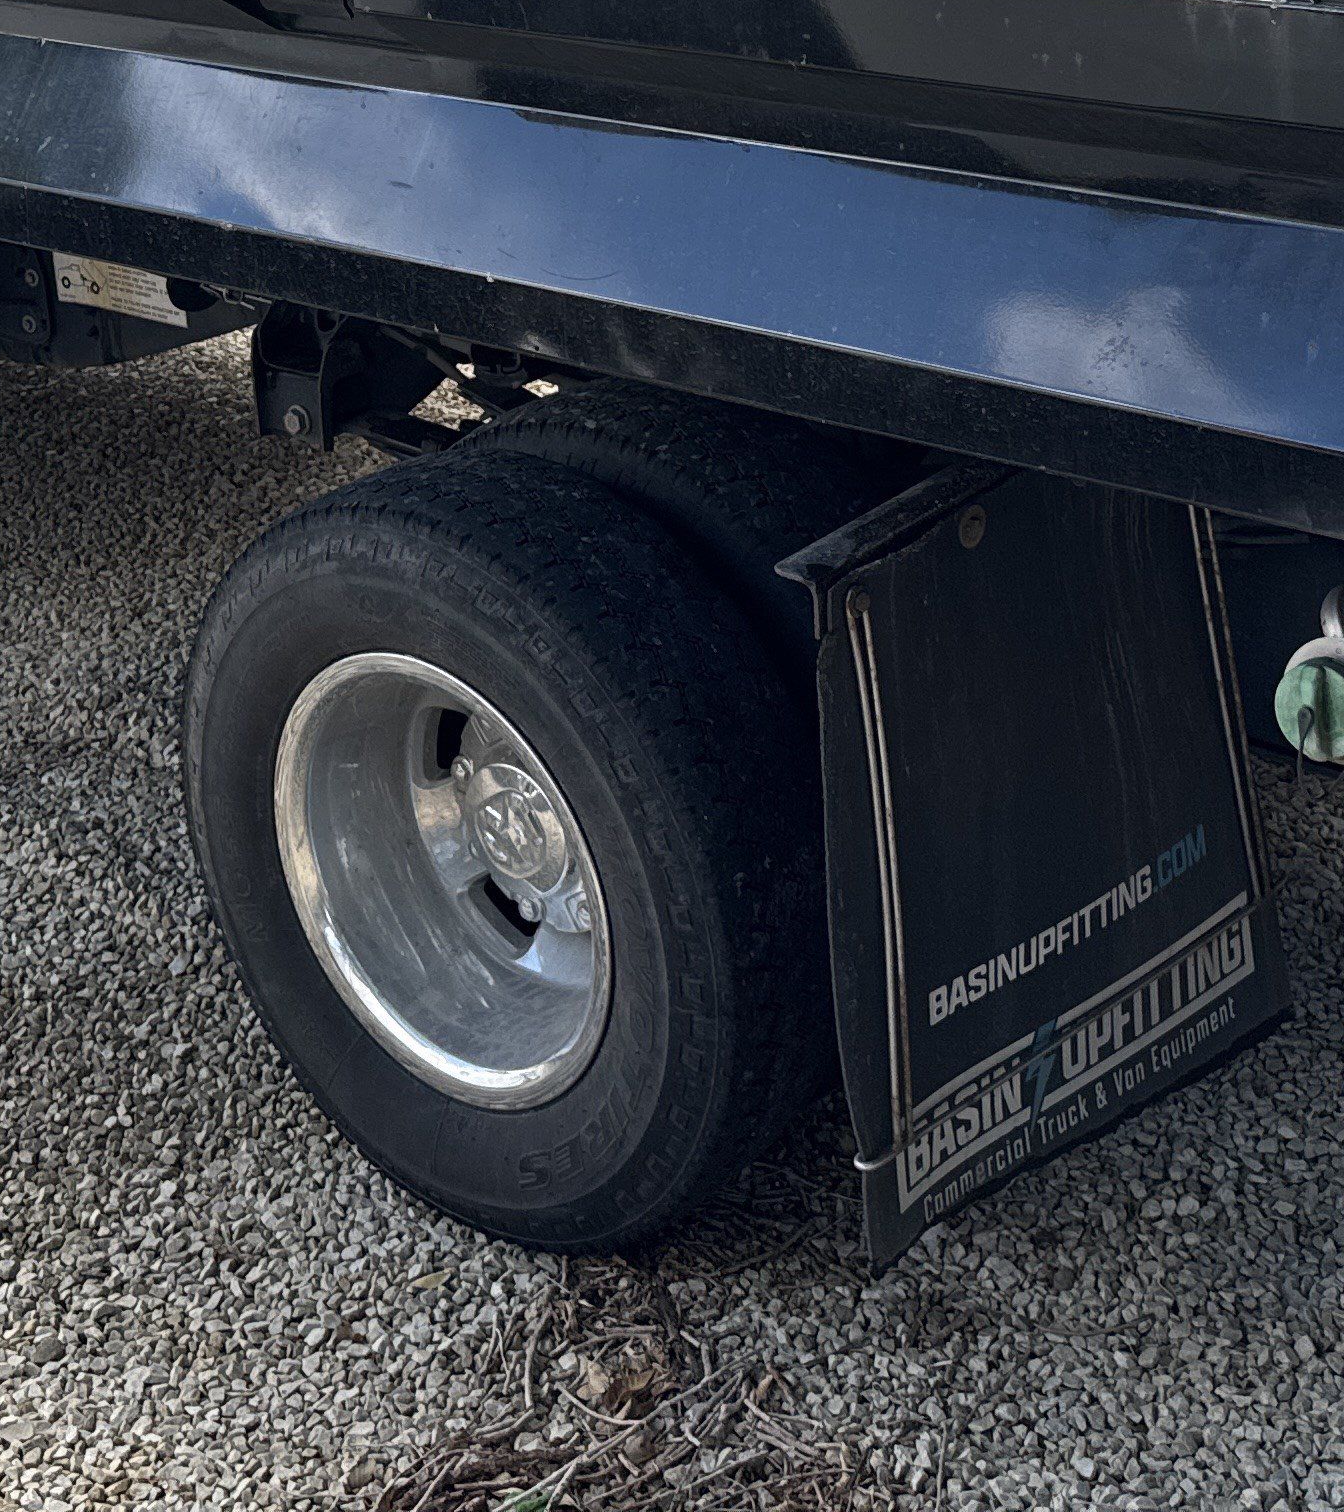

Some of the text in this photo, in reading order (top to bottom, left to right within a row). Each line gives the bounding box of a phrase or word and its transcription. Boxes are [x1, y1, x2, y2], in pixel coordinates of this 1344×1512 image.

[928, 824, 1207, 1027] BASINUPFITTING.COM
[908, 923, 1242, 1187] BASIN UPFITTING
[923, 996, 1236, 1224] Commercial Truck & Van Equipment
